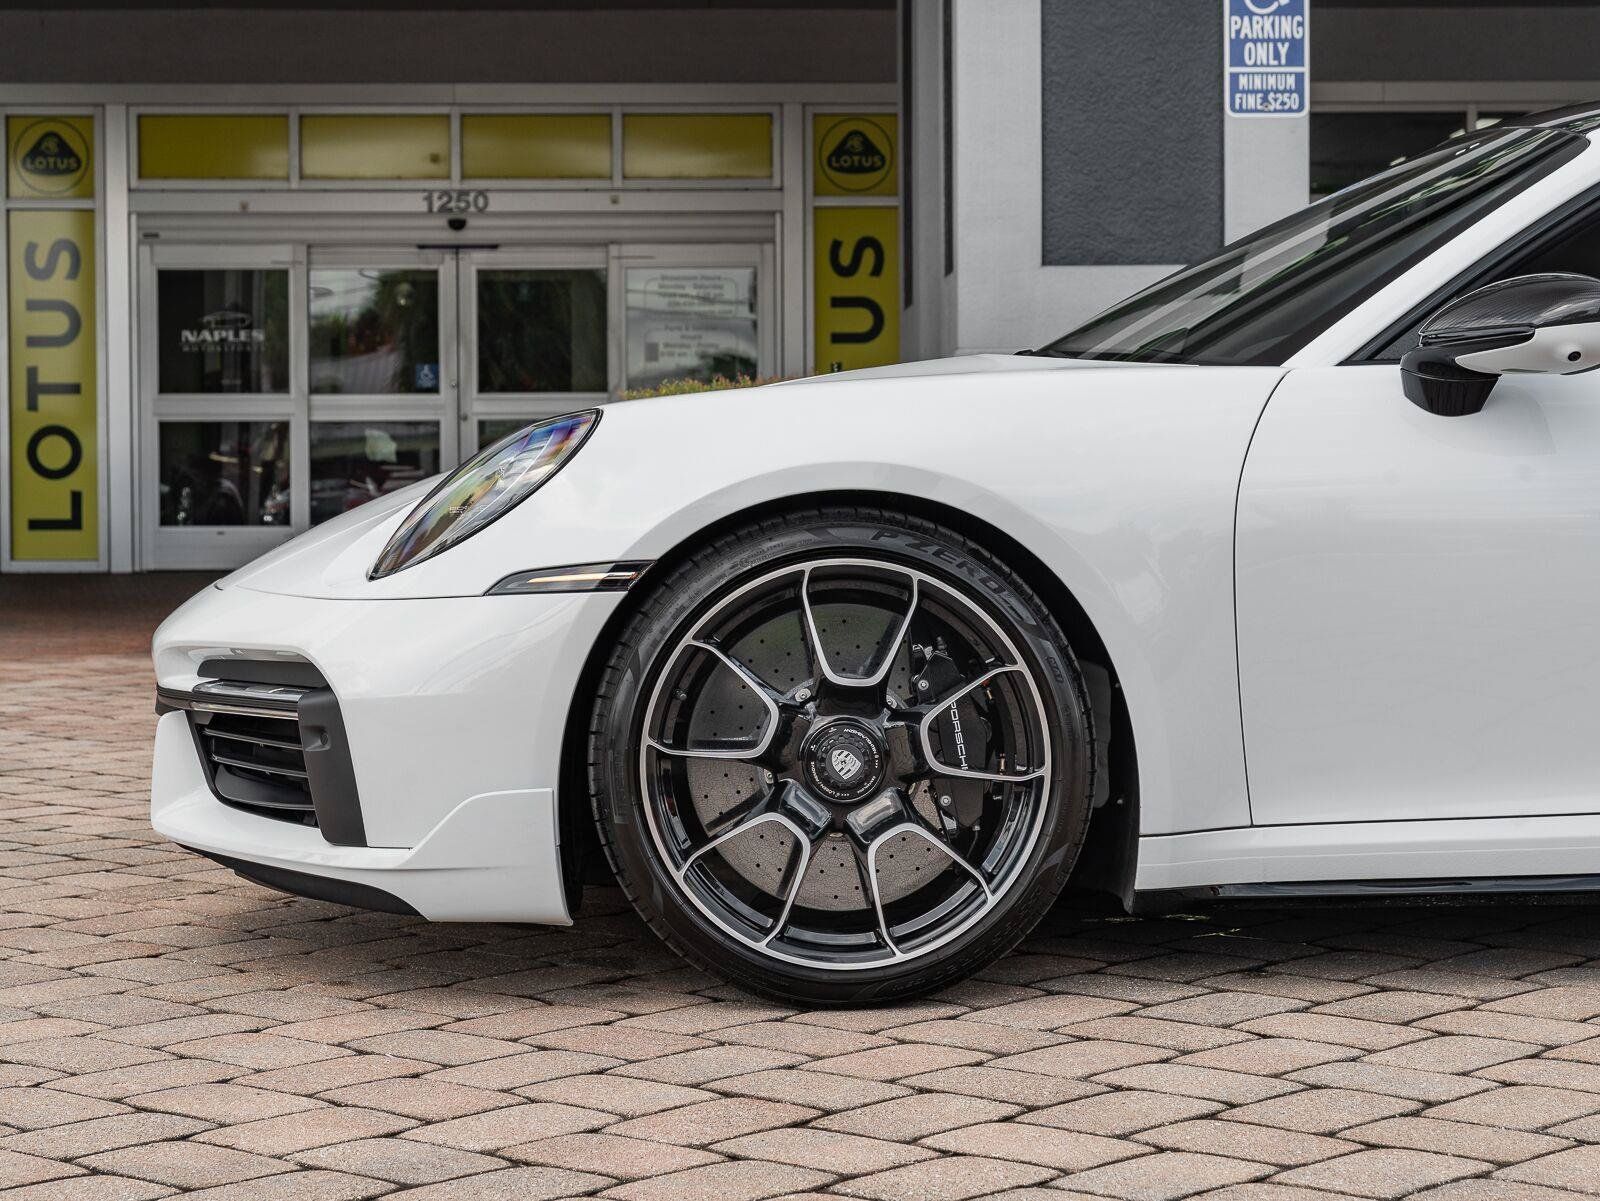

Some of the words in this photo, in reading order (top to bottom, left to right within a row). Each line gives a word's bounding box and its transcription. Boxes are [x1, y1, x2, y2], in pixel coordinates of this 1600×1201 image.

[1230, 15, 1303, 39] PARKING
[1243, 41, 1290, 66] ONLY
[1238, 73, 1296, 91] MINIMUM
[1234, 92, 1264, 111] FINE
[1267, 91, 1300, 112] $250
[26, 155, 79, 170] LOTUS
[831, 155, 883, 168] LOTUS
[422, 190, 489, 213] 1250
[829, 235, 886, 372] US
[181, 328, 266, 343] NAPLES
[24, 236, 83, 532] LOTUS
